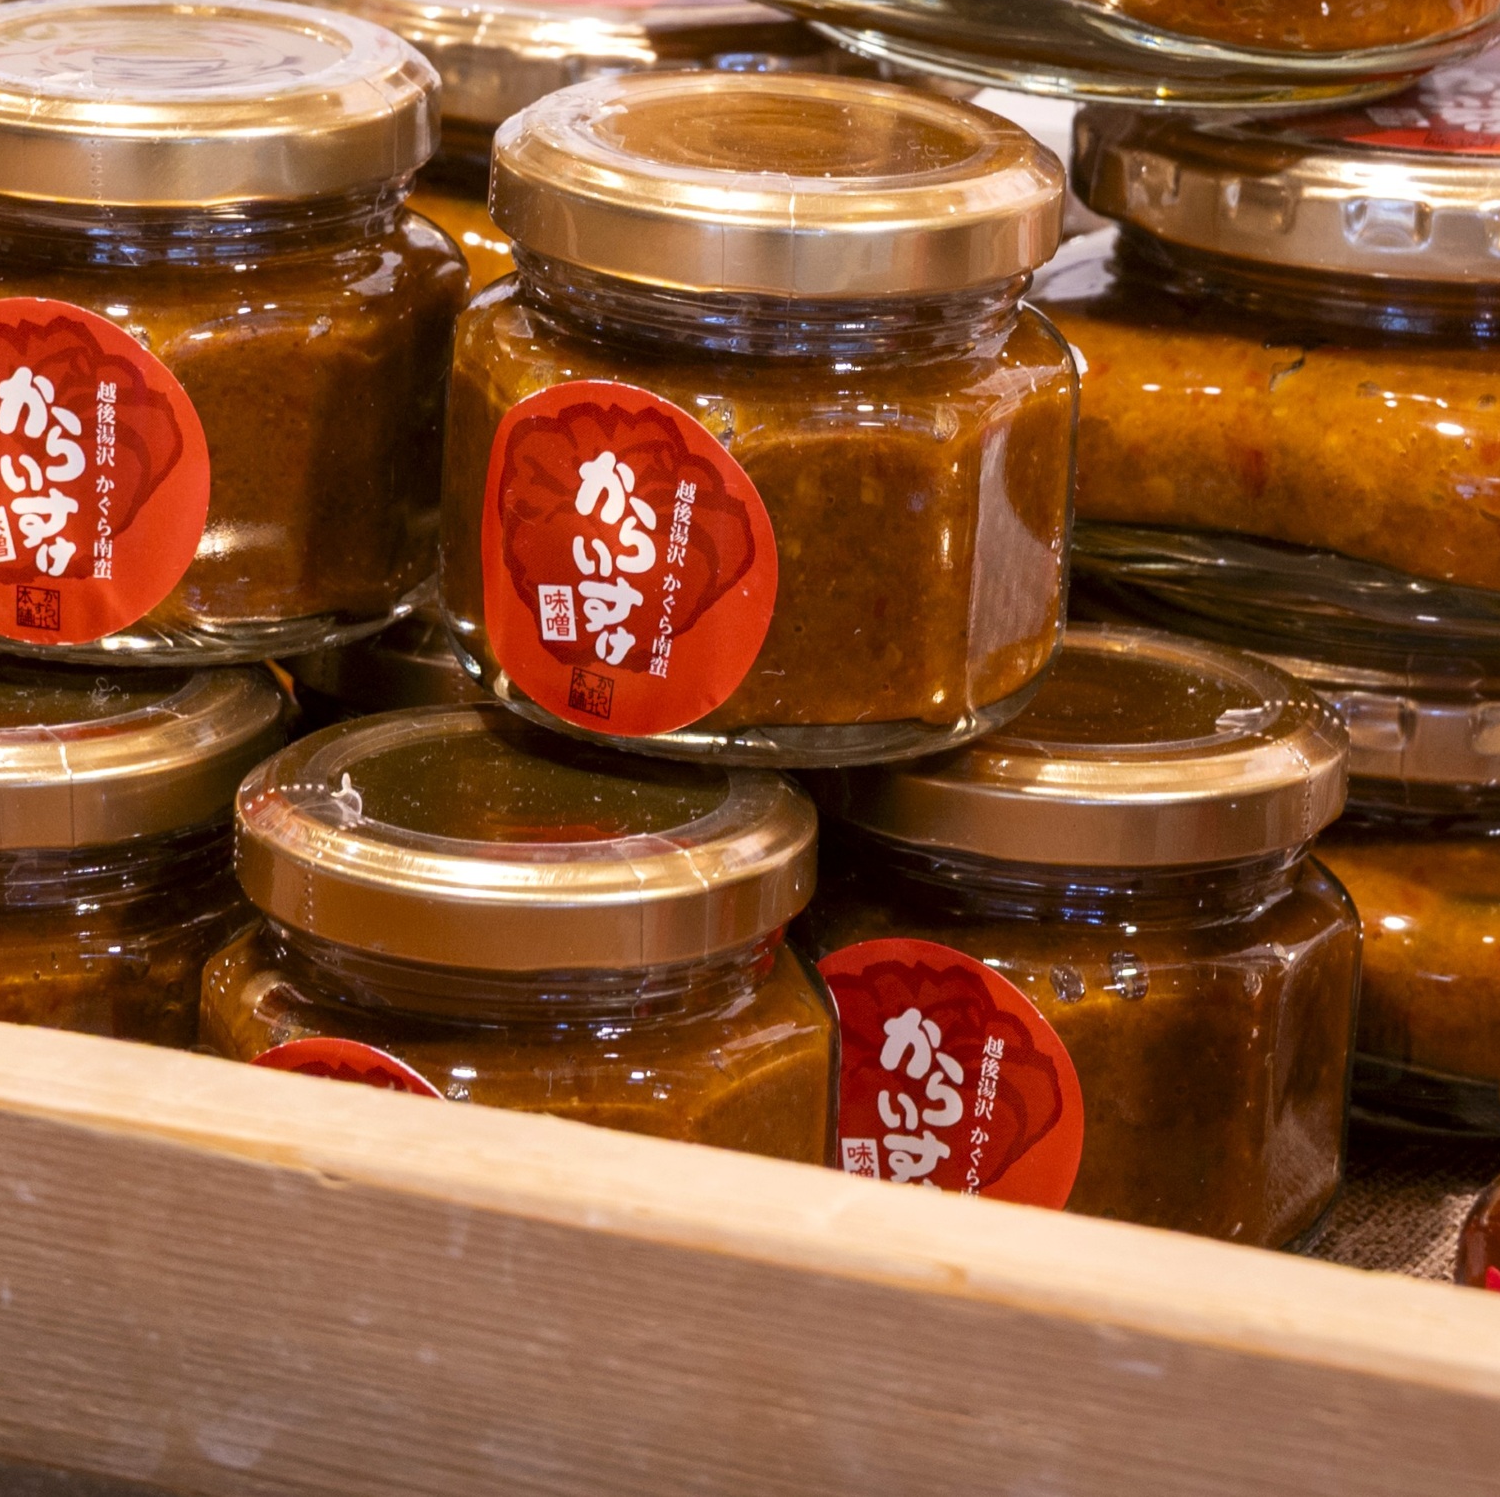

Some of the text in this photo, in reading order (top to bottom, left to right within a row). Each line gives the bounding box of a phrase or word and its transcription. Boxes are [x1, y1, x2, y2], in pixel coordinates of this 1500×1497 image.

[92, 381, 118, 581] 越後湯沢 かぐら南蛮
[571, 449, 658, 666] からいすけ
[649, 479, 698, 679] 越後湯沢 かぐら南蛮
[543, 589, 571, 638] 味噌
[974, 1035, 1005, 1121] 越後湯沢
